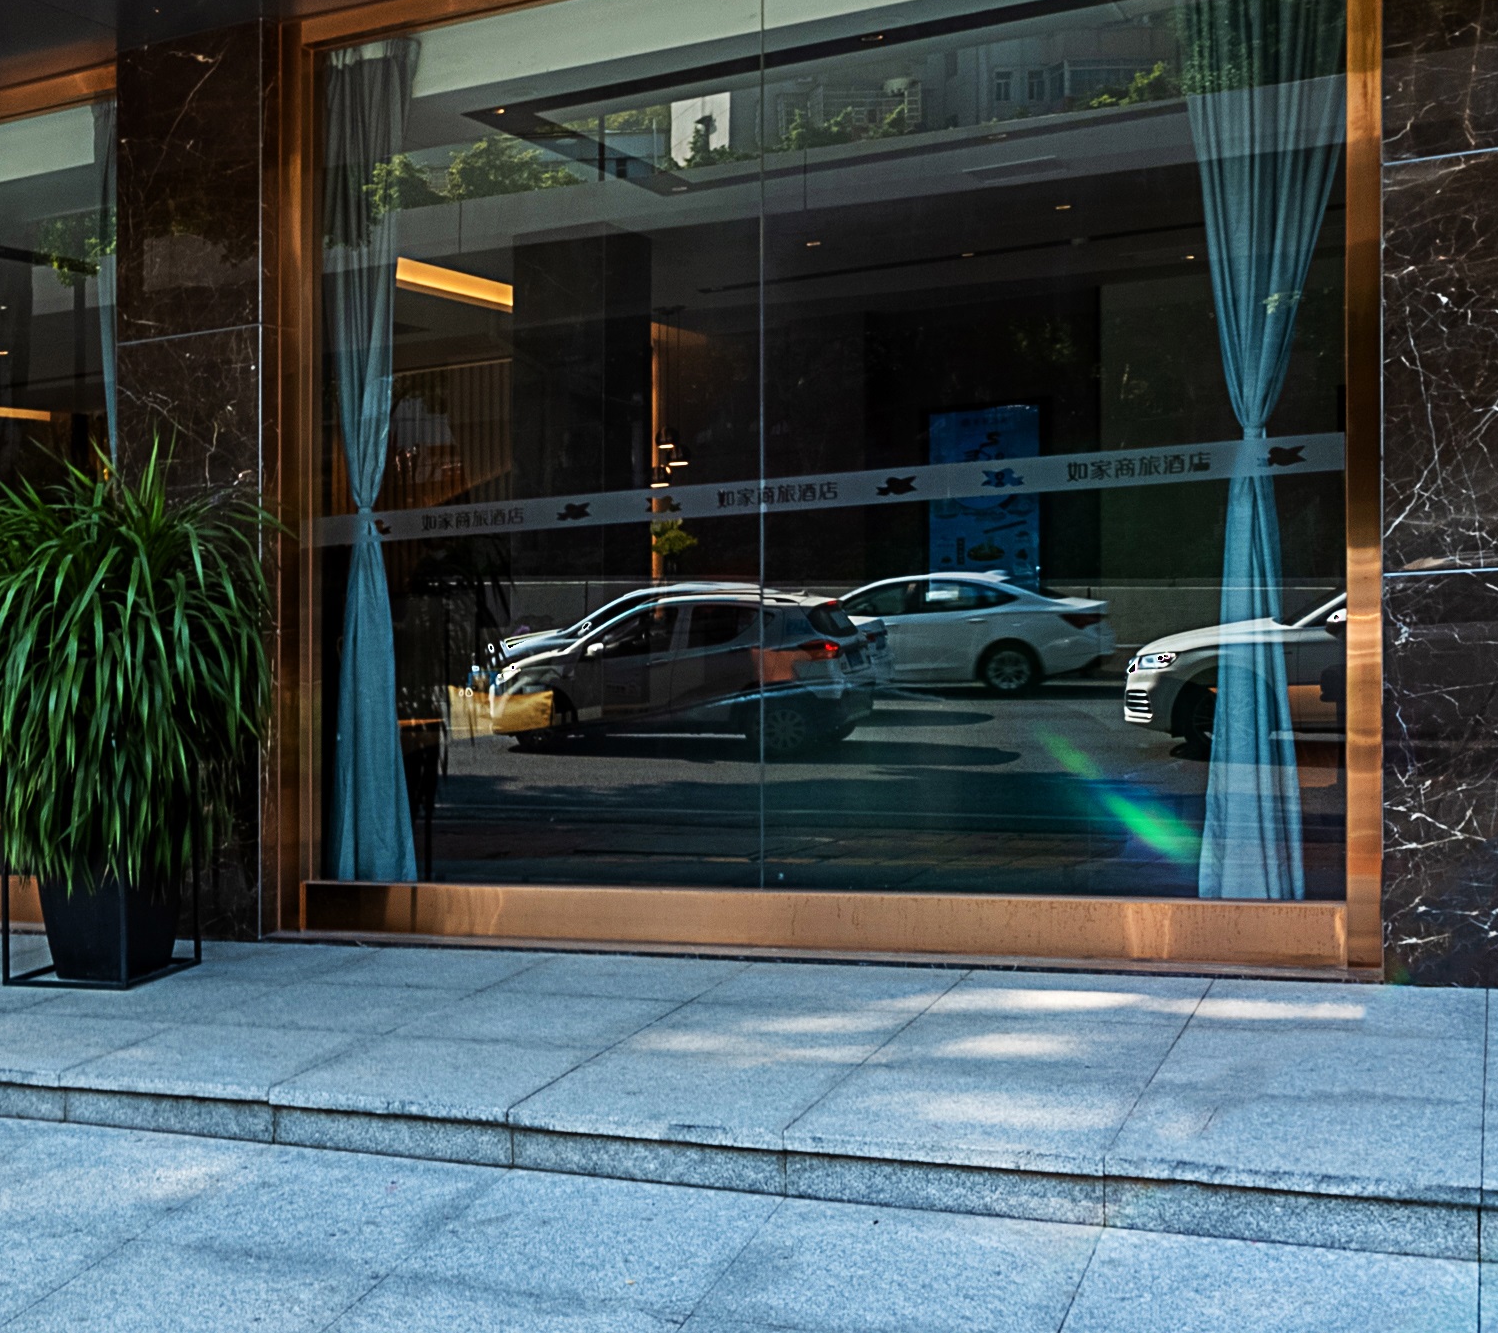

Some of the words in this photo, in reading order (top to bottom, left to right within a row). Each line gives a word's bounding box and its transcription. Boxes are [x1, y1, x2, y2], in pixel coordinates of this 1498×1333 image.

[1066, 452, 1211, 483] 如家商旅酒店
[717, 482, 838, 508] 如家商旅酒店
[421, 507, 524, 531] 如家商旅酒店
